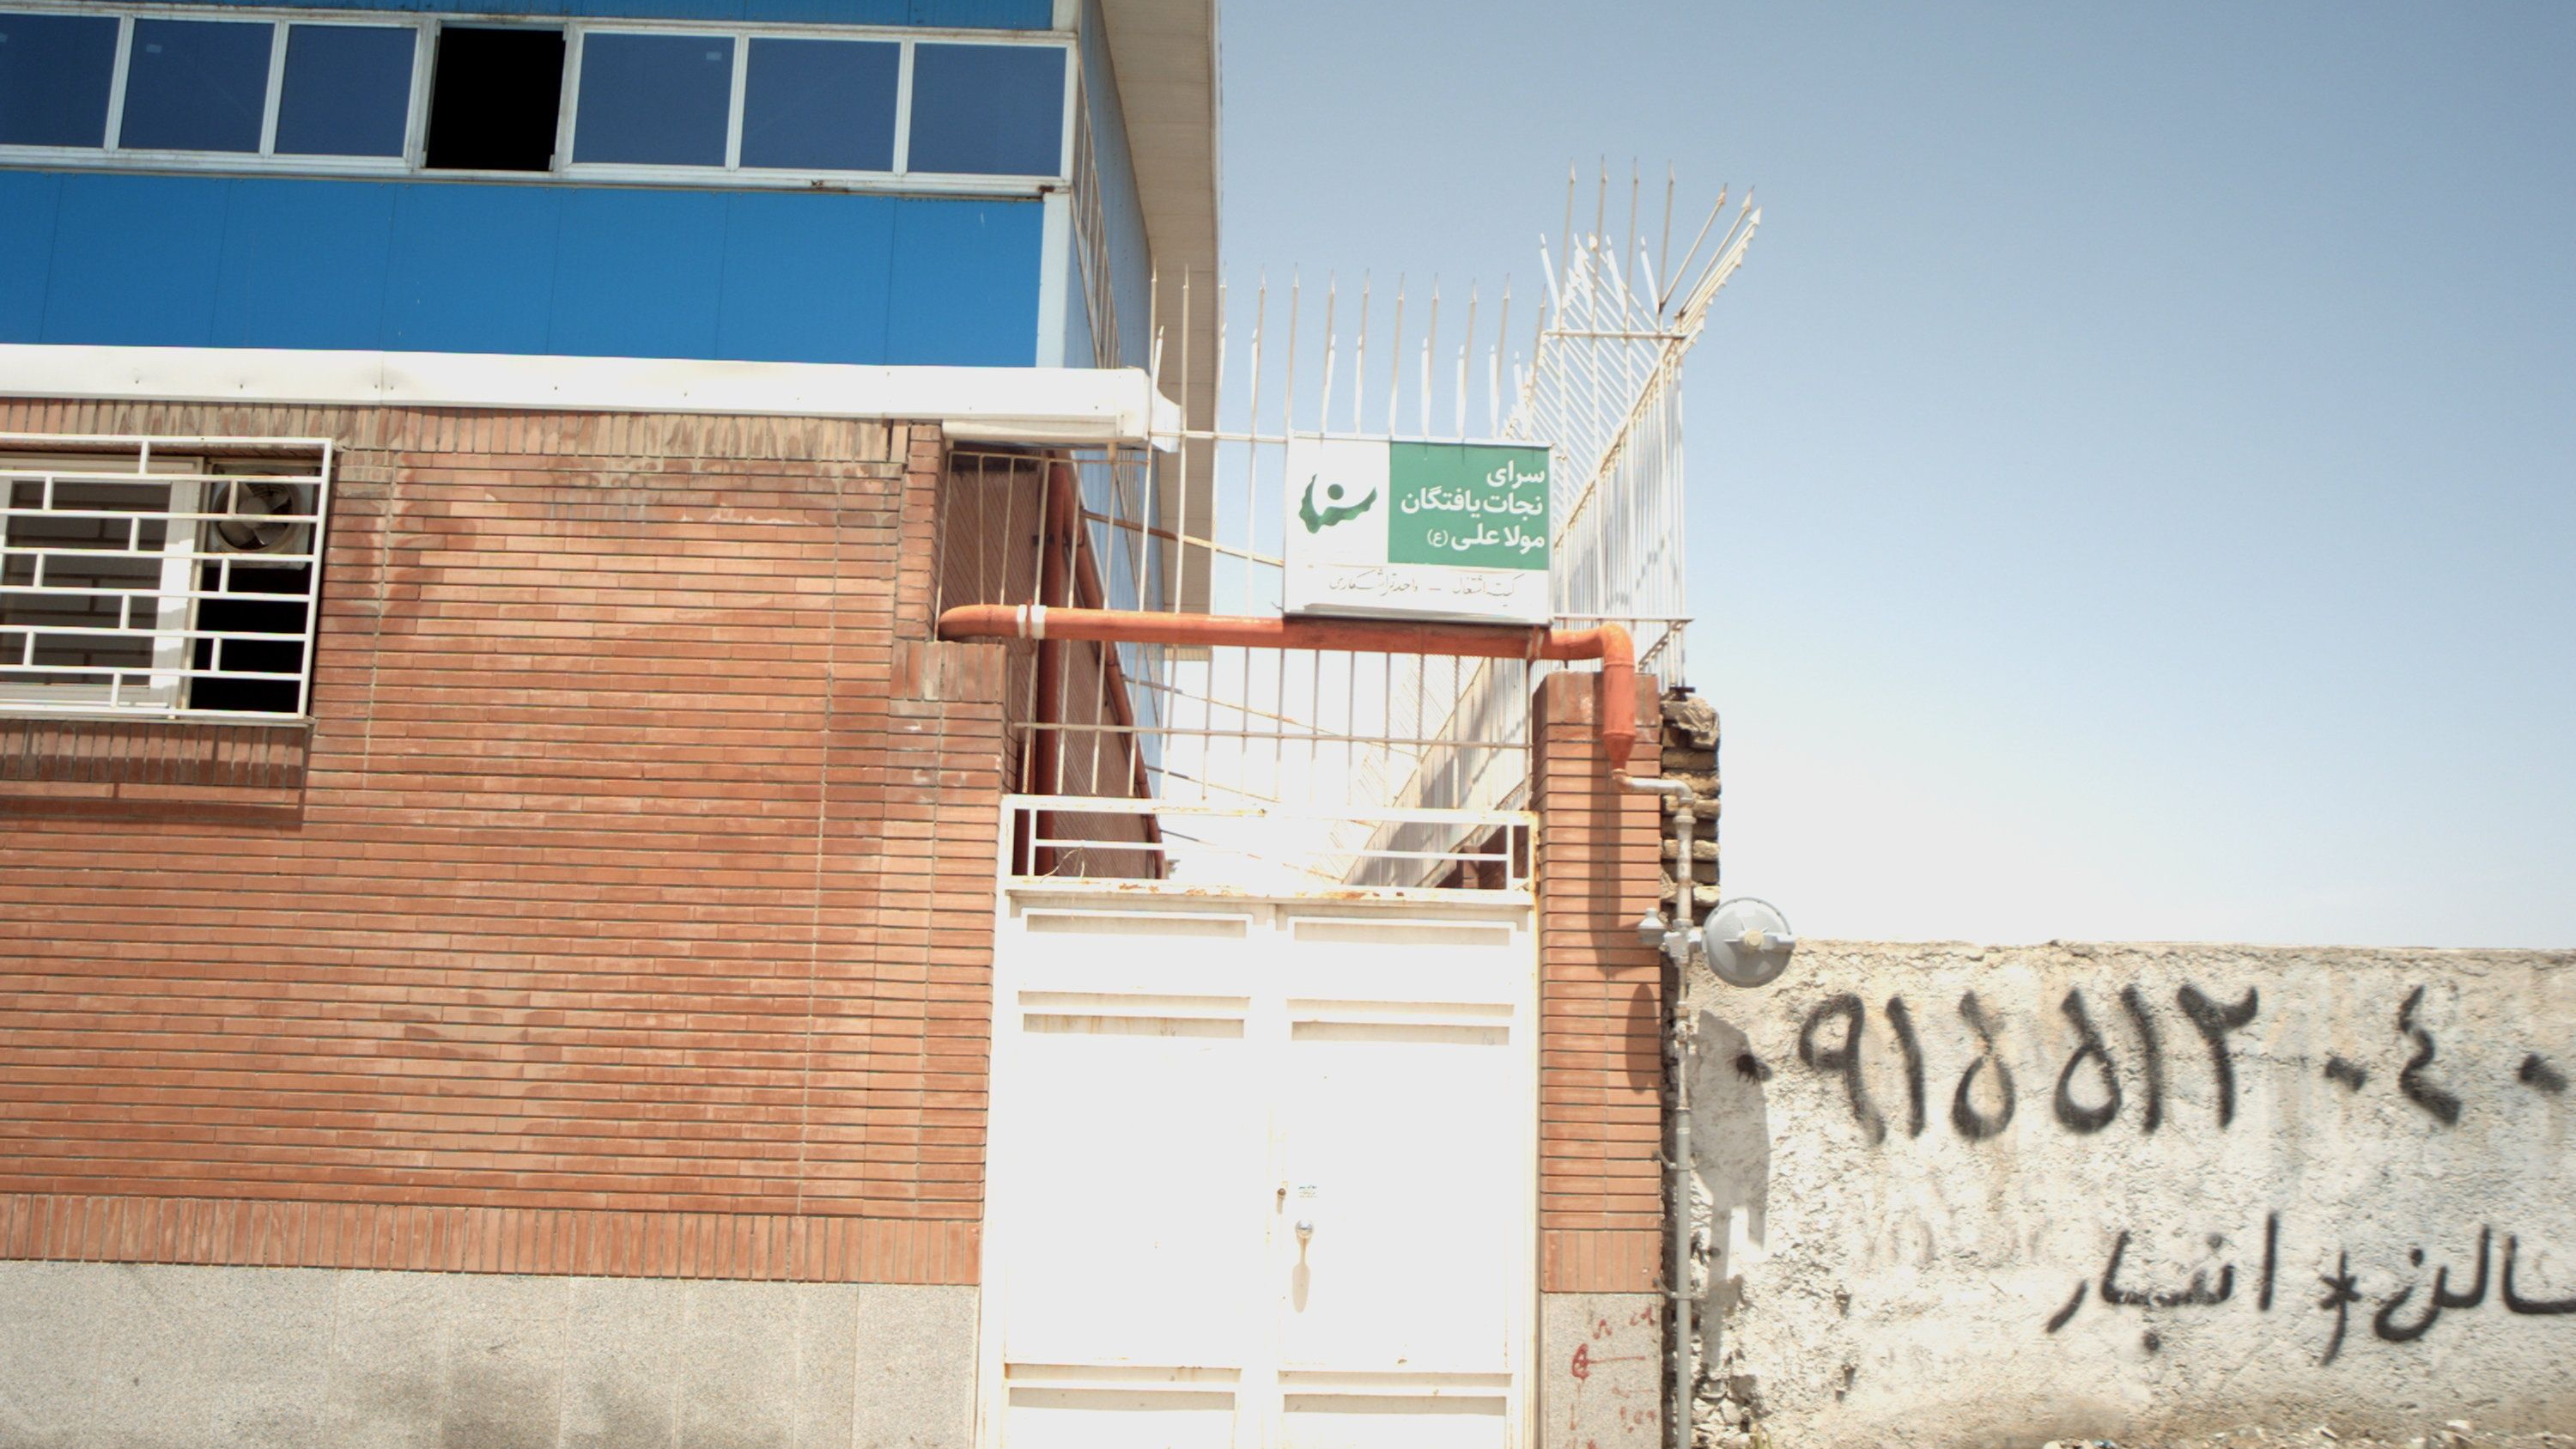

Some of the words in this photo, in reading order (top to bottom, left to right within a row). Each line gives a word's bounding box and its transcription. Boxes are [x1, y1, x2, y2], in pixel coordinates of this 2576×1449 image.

[1486, 460, 1546, 490] سرای
[1400, 485, 1481, 518] یافتگان
[1483, 492, 1544, 521] نجات
[1451, 522, 1501, 551] علی
[1504, 525, 1546, 555] مولا
[2372, 1221, 2576, 1343] الن
